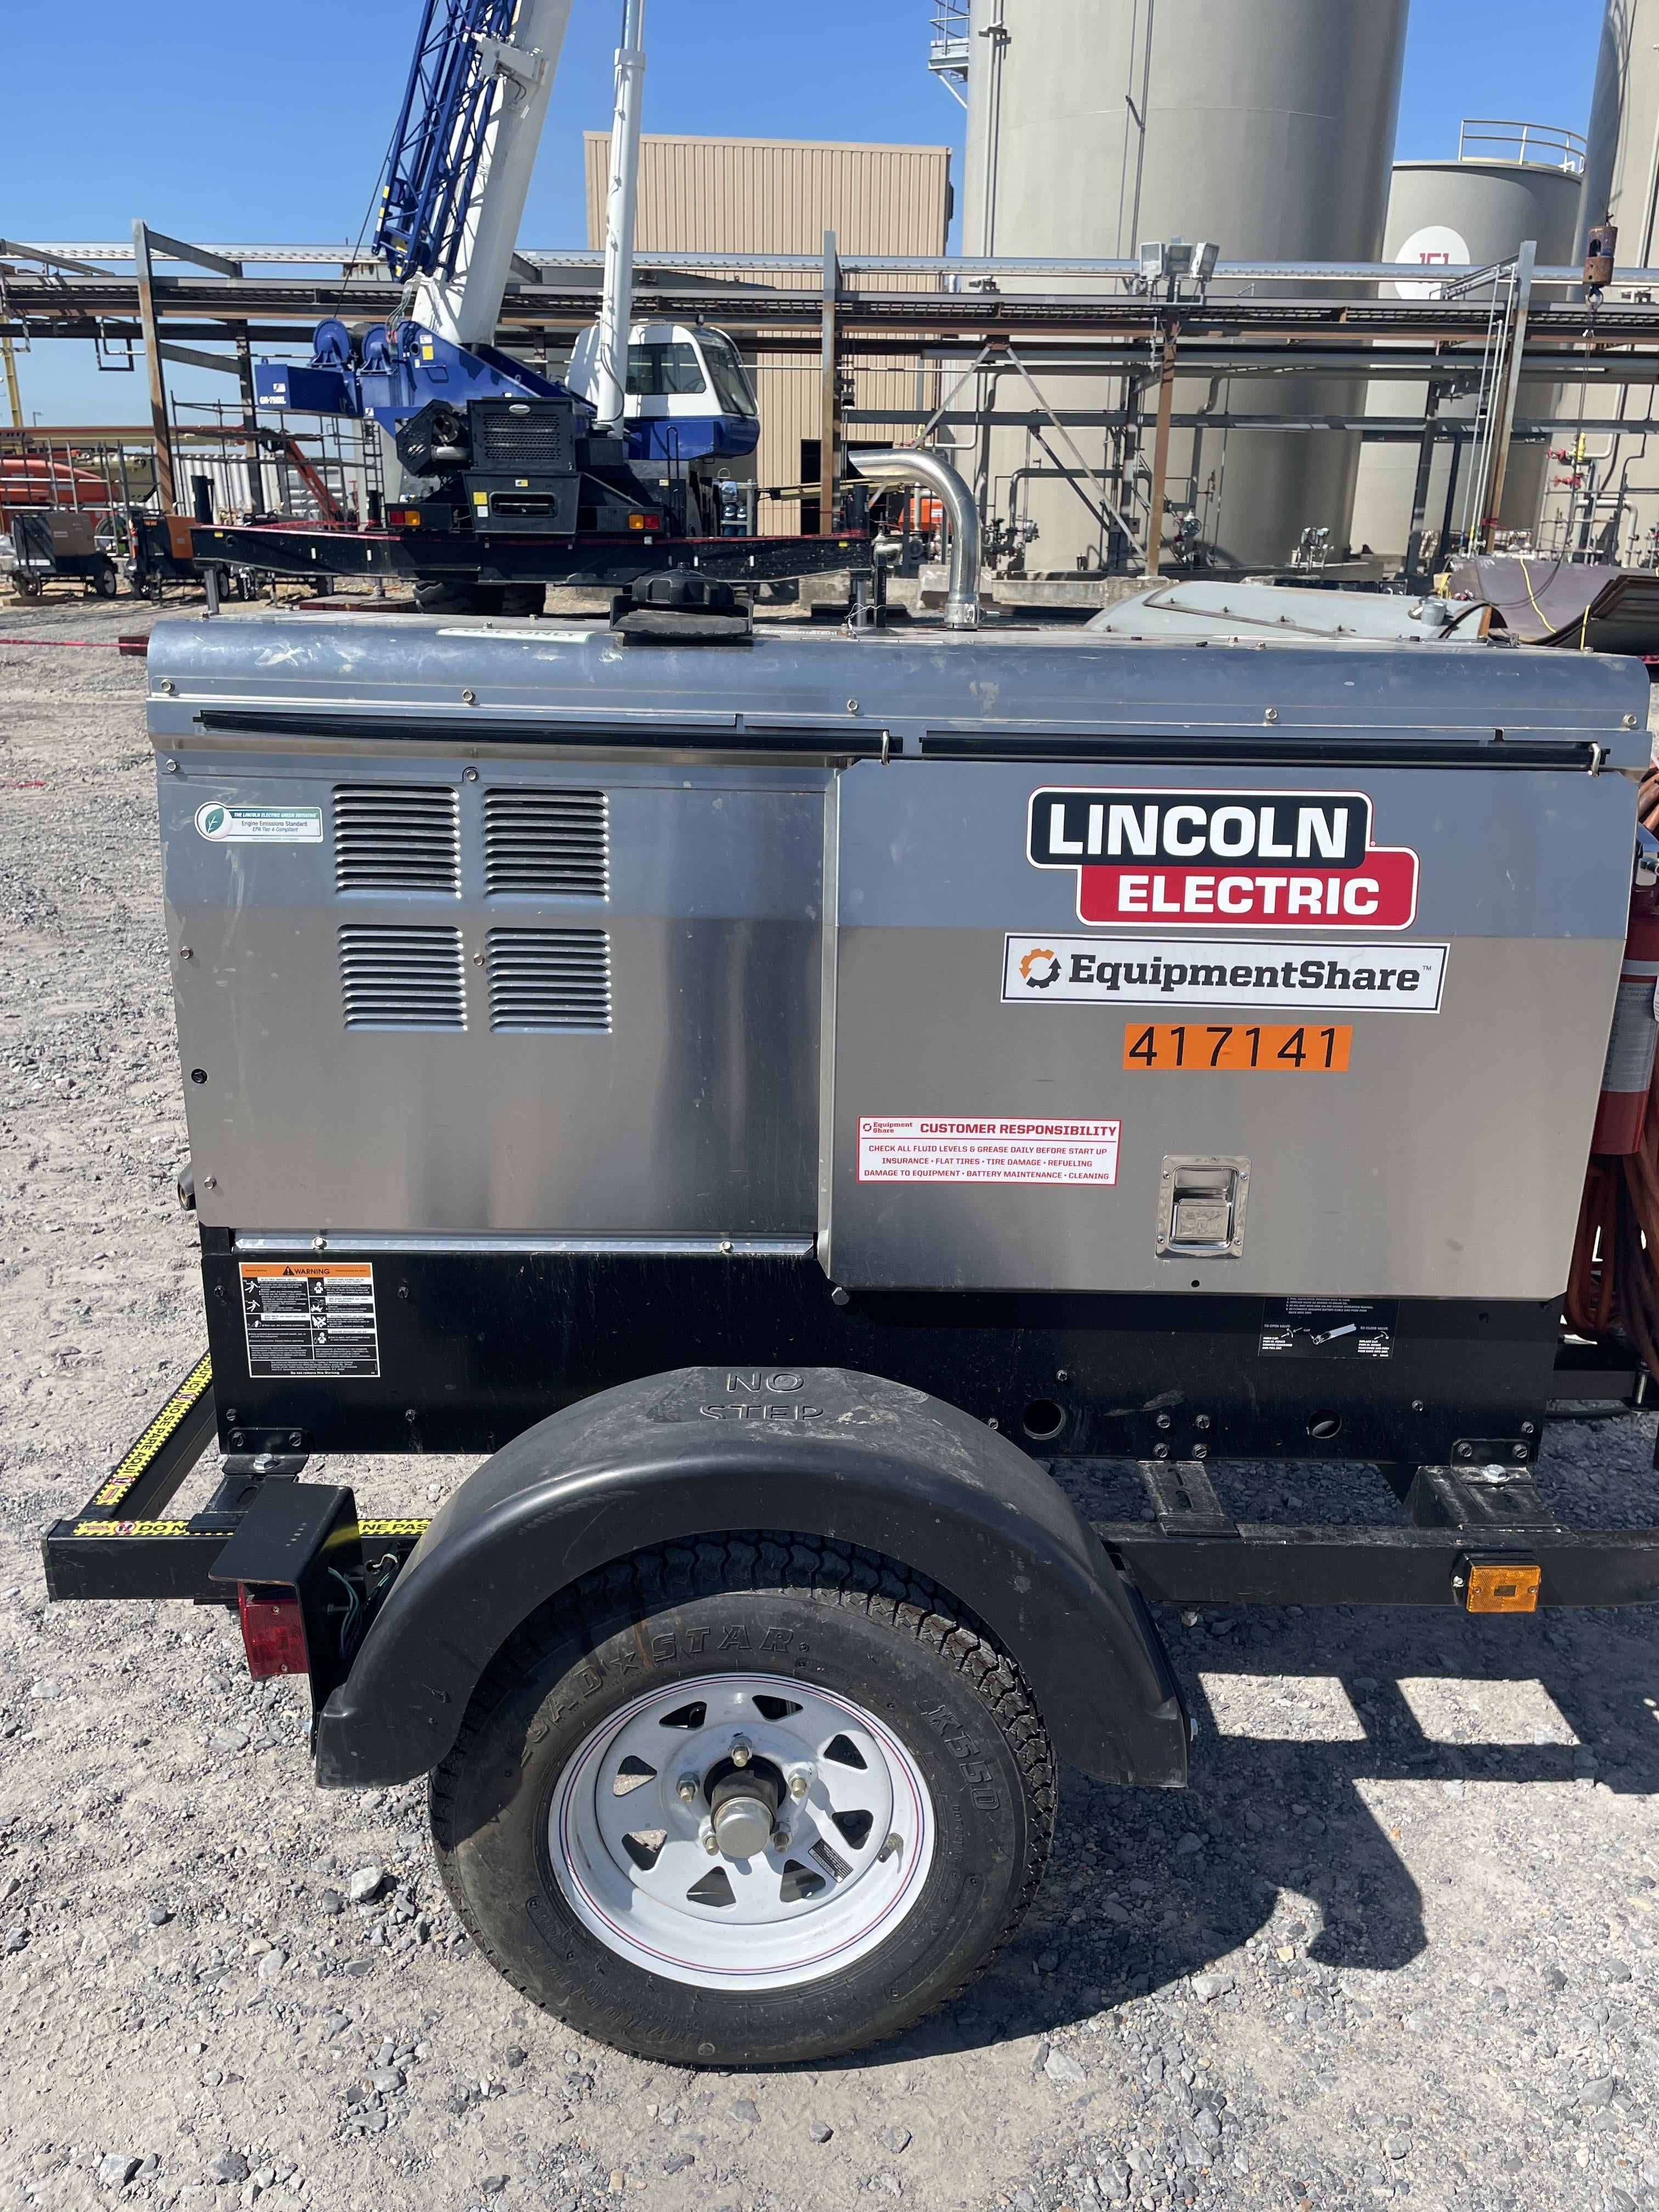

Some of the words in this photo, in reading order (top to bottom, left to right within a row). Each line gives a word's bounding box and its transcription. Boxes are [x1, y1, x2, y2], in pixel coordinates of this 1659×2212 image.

[1049, 803, 1348, 859] LINCOLN
[1118, 874, 1380, 916] ELECTRIC
[1069, 953, 1420, 992] EquipmentShare
[1128, 1025, 1336, 1068] 417141
[921, 1124, 996, 1134] CUSTOMER
[1000, 1125, 1116, 1136] RESPONSIBILITY
[187, 1381, 202, 1390] ICI
[726, 1372, 805, 1393] NO
[170, 1402, 185, 1413] NO
[699, 1404, 824, 1421] STEP
[159, 1415, 174, 1426] SE
[141, 1428, 166, 1450] PARE
[651, 1624, 794, 1662] STAR
[812, 1852, 832, 1874] WARNING
